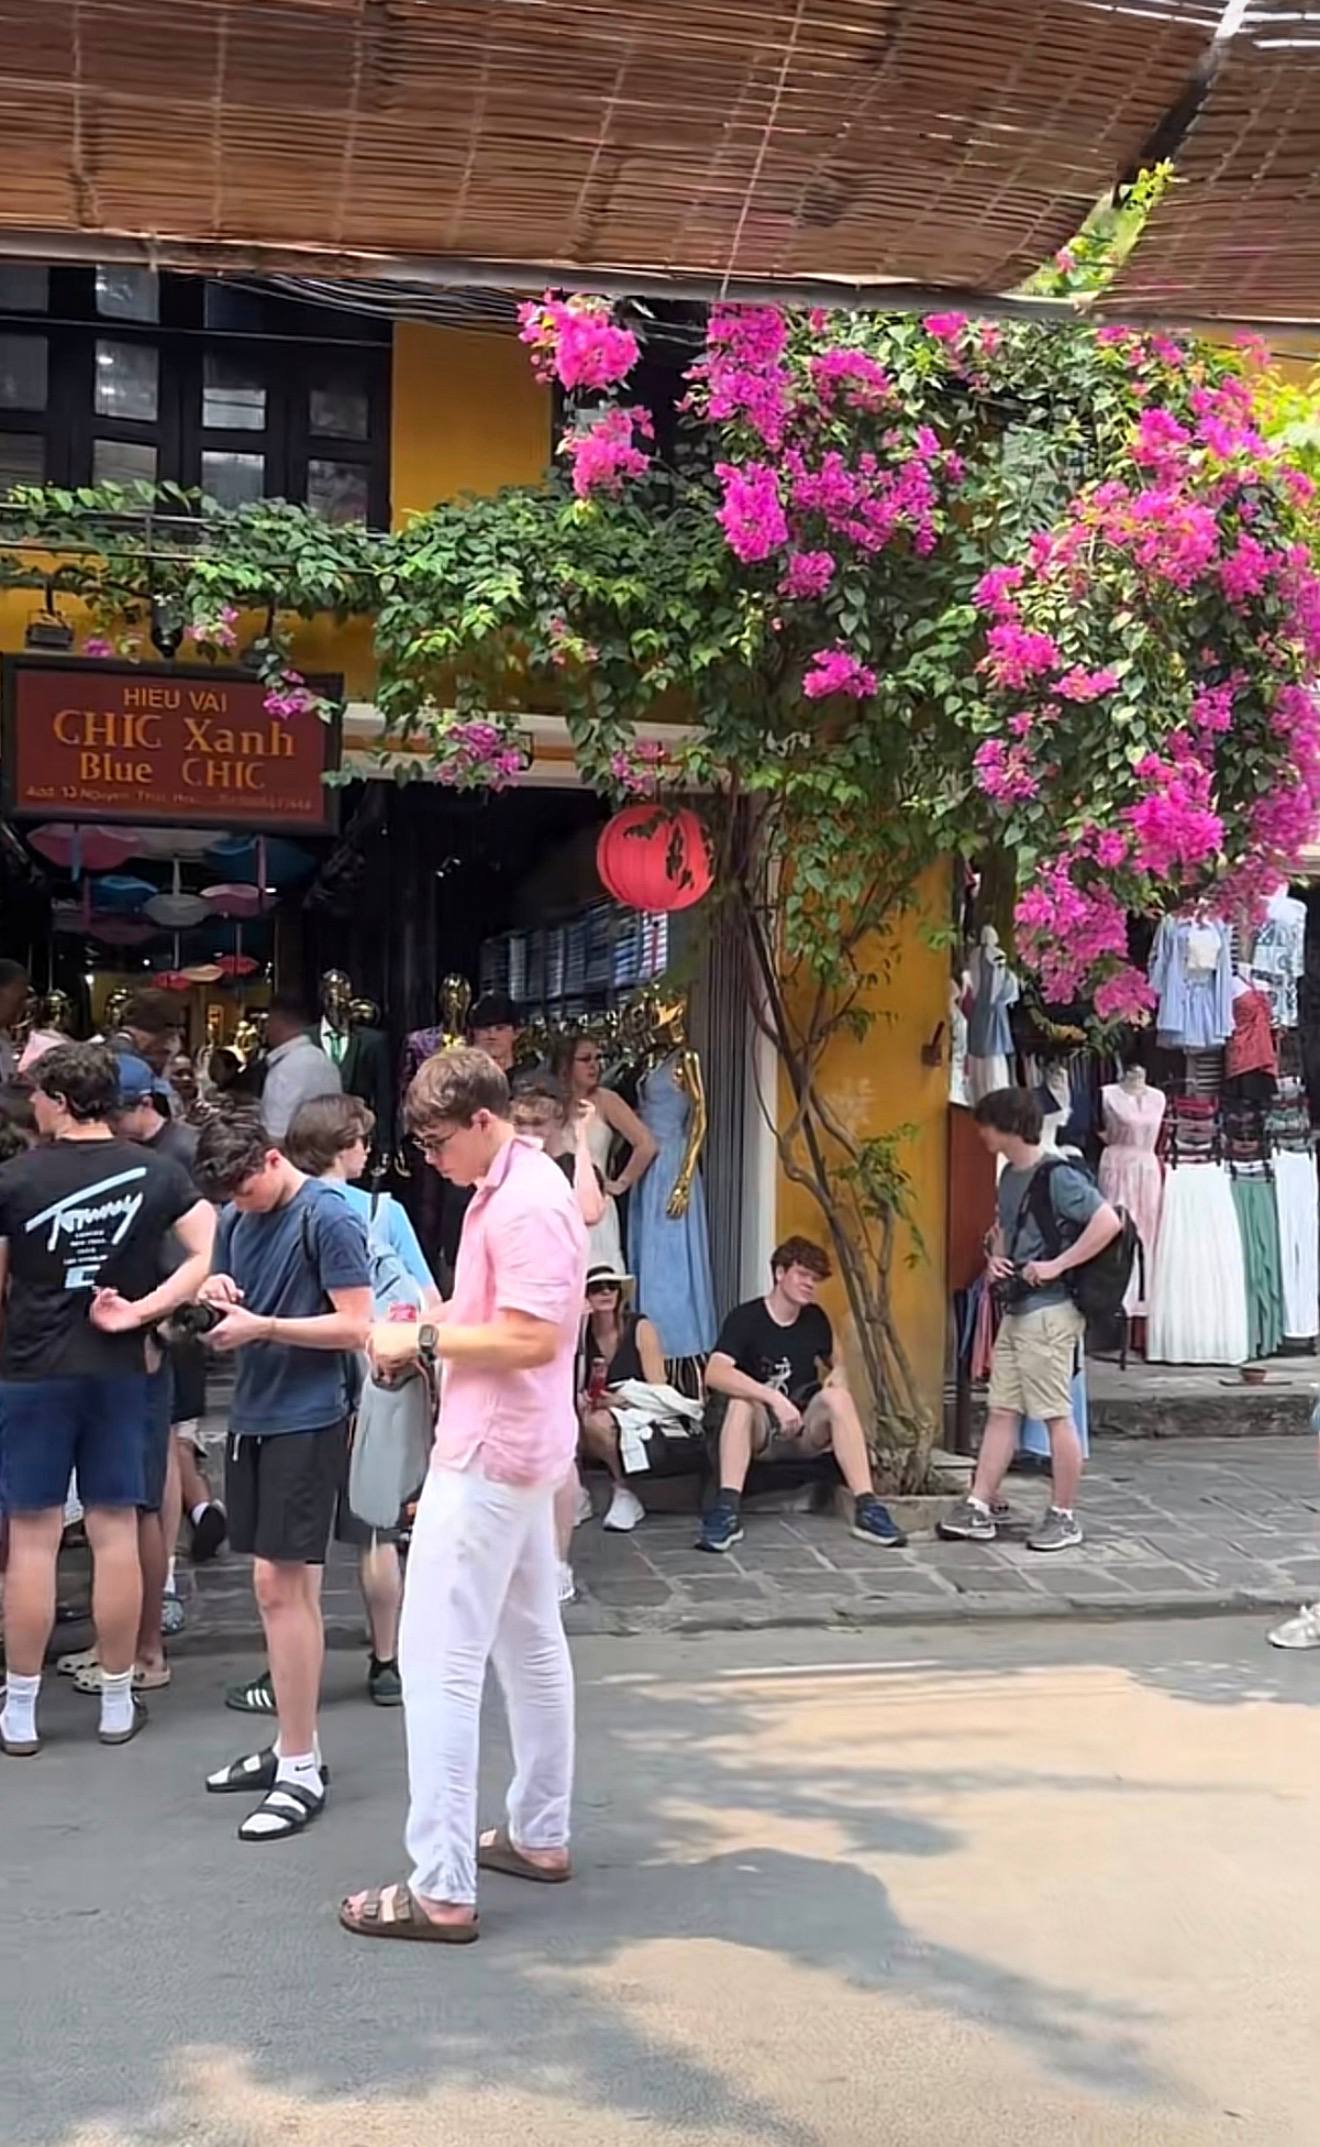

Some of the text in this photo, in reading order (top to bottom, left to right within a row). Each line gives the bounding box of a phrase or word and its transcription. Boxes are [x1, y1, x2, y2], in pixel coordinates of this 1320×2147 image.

[53, 709, 295, 757] CHIC Xanh
[79, 752, 266, 790] Blue CHIC
[25, 1166, 147, 1252] Tommy
